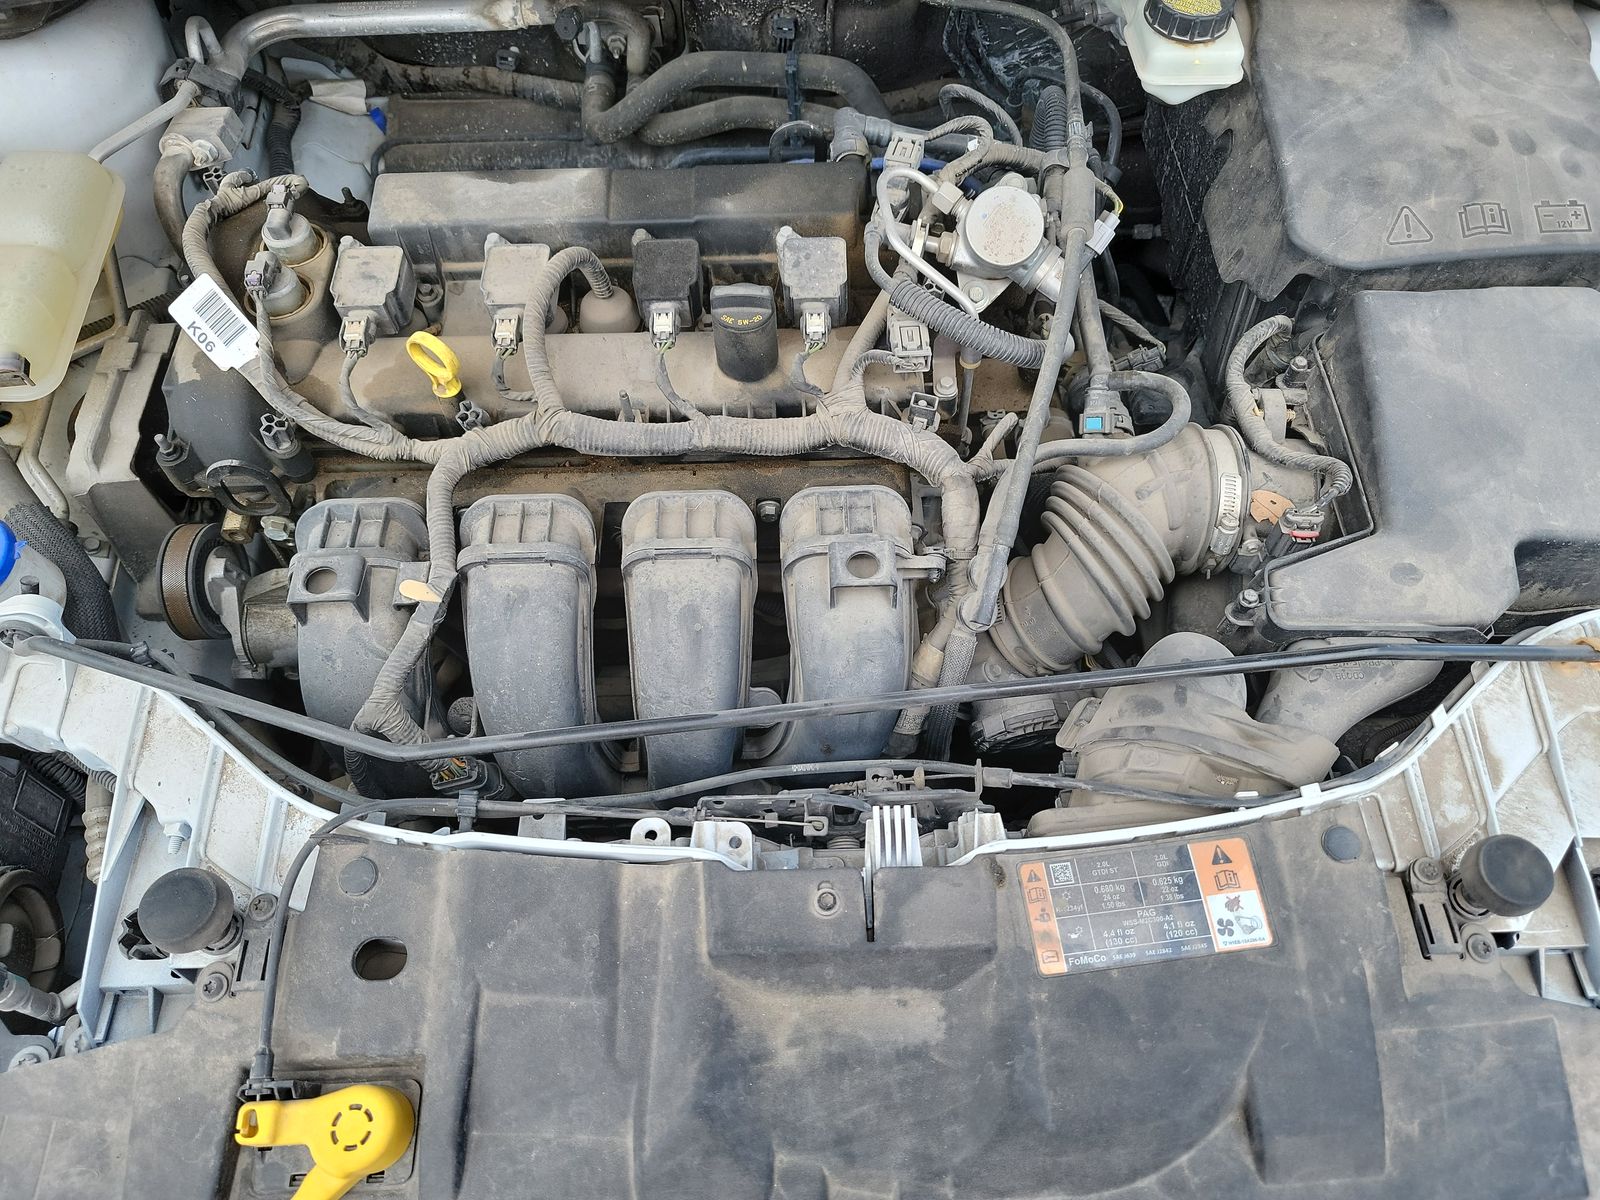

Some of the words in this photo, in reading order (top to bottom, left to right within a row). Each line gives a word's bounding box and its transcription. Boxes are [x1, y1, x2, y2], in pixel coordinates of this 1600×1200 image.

[1556, 220, 1574, 228] 12V
[720, 314, 734, 324] SAE
[738, 314, 763, 325] 5W-20
[187, 321, 216, 352] K06
[1152, 877, 1172, 886] 0.625
[1173, 876, 1184, 885] kg
[1094, 884, 1114, 893] 0.680
[1115, 883, 1126, 892] kg
[1136, 908, 1156, 918] PAG
[1163, 922, 1175, 930] 4.1
[1103, 929, 1115, 938] 4.4
[1165, 930, 1183, 940] (120
[1185, 928, 1198, 936] cc)
[1105, 938, 1121, 948] (130
[1068, 954, 1106, 966] FoMoCo
